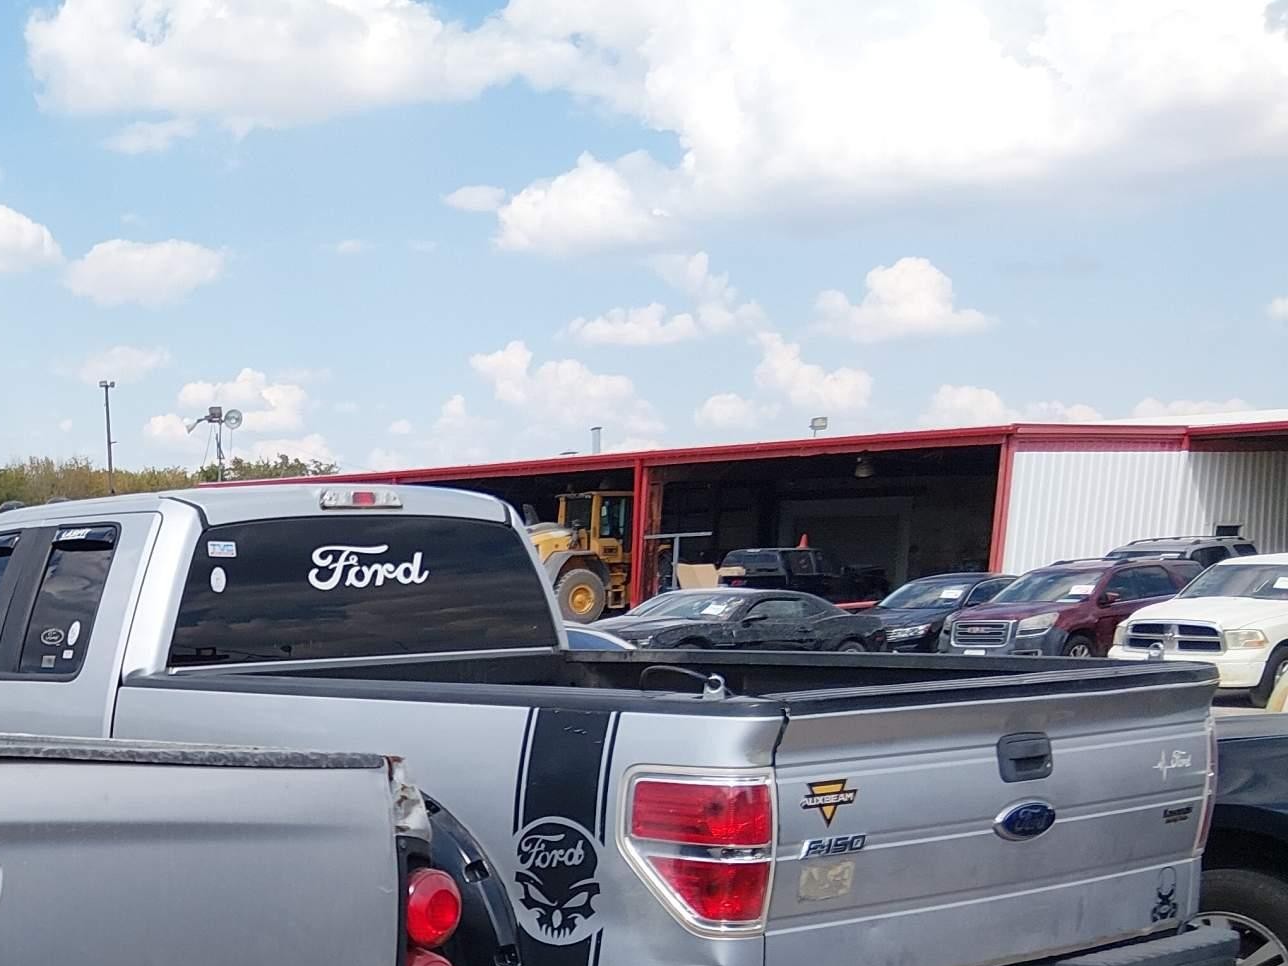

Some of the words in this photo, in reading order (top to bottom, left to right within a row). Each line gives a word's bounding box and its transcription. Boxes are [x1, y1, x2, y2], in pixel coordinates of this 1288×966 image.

[308, 544, 430, 591] Ford
[800, 791, 855, 810] AUXBEAM
[517, 833, 585, 870] Ford
[801, 834, 867, 859] F-150
